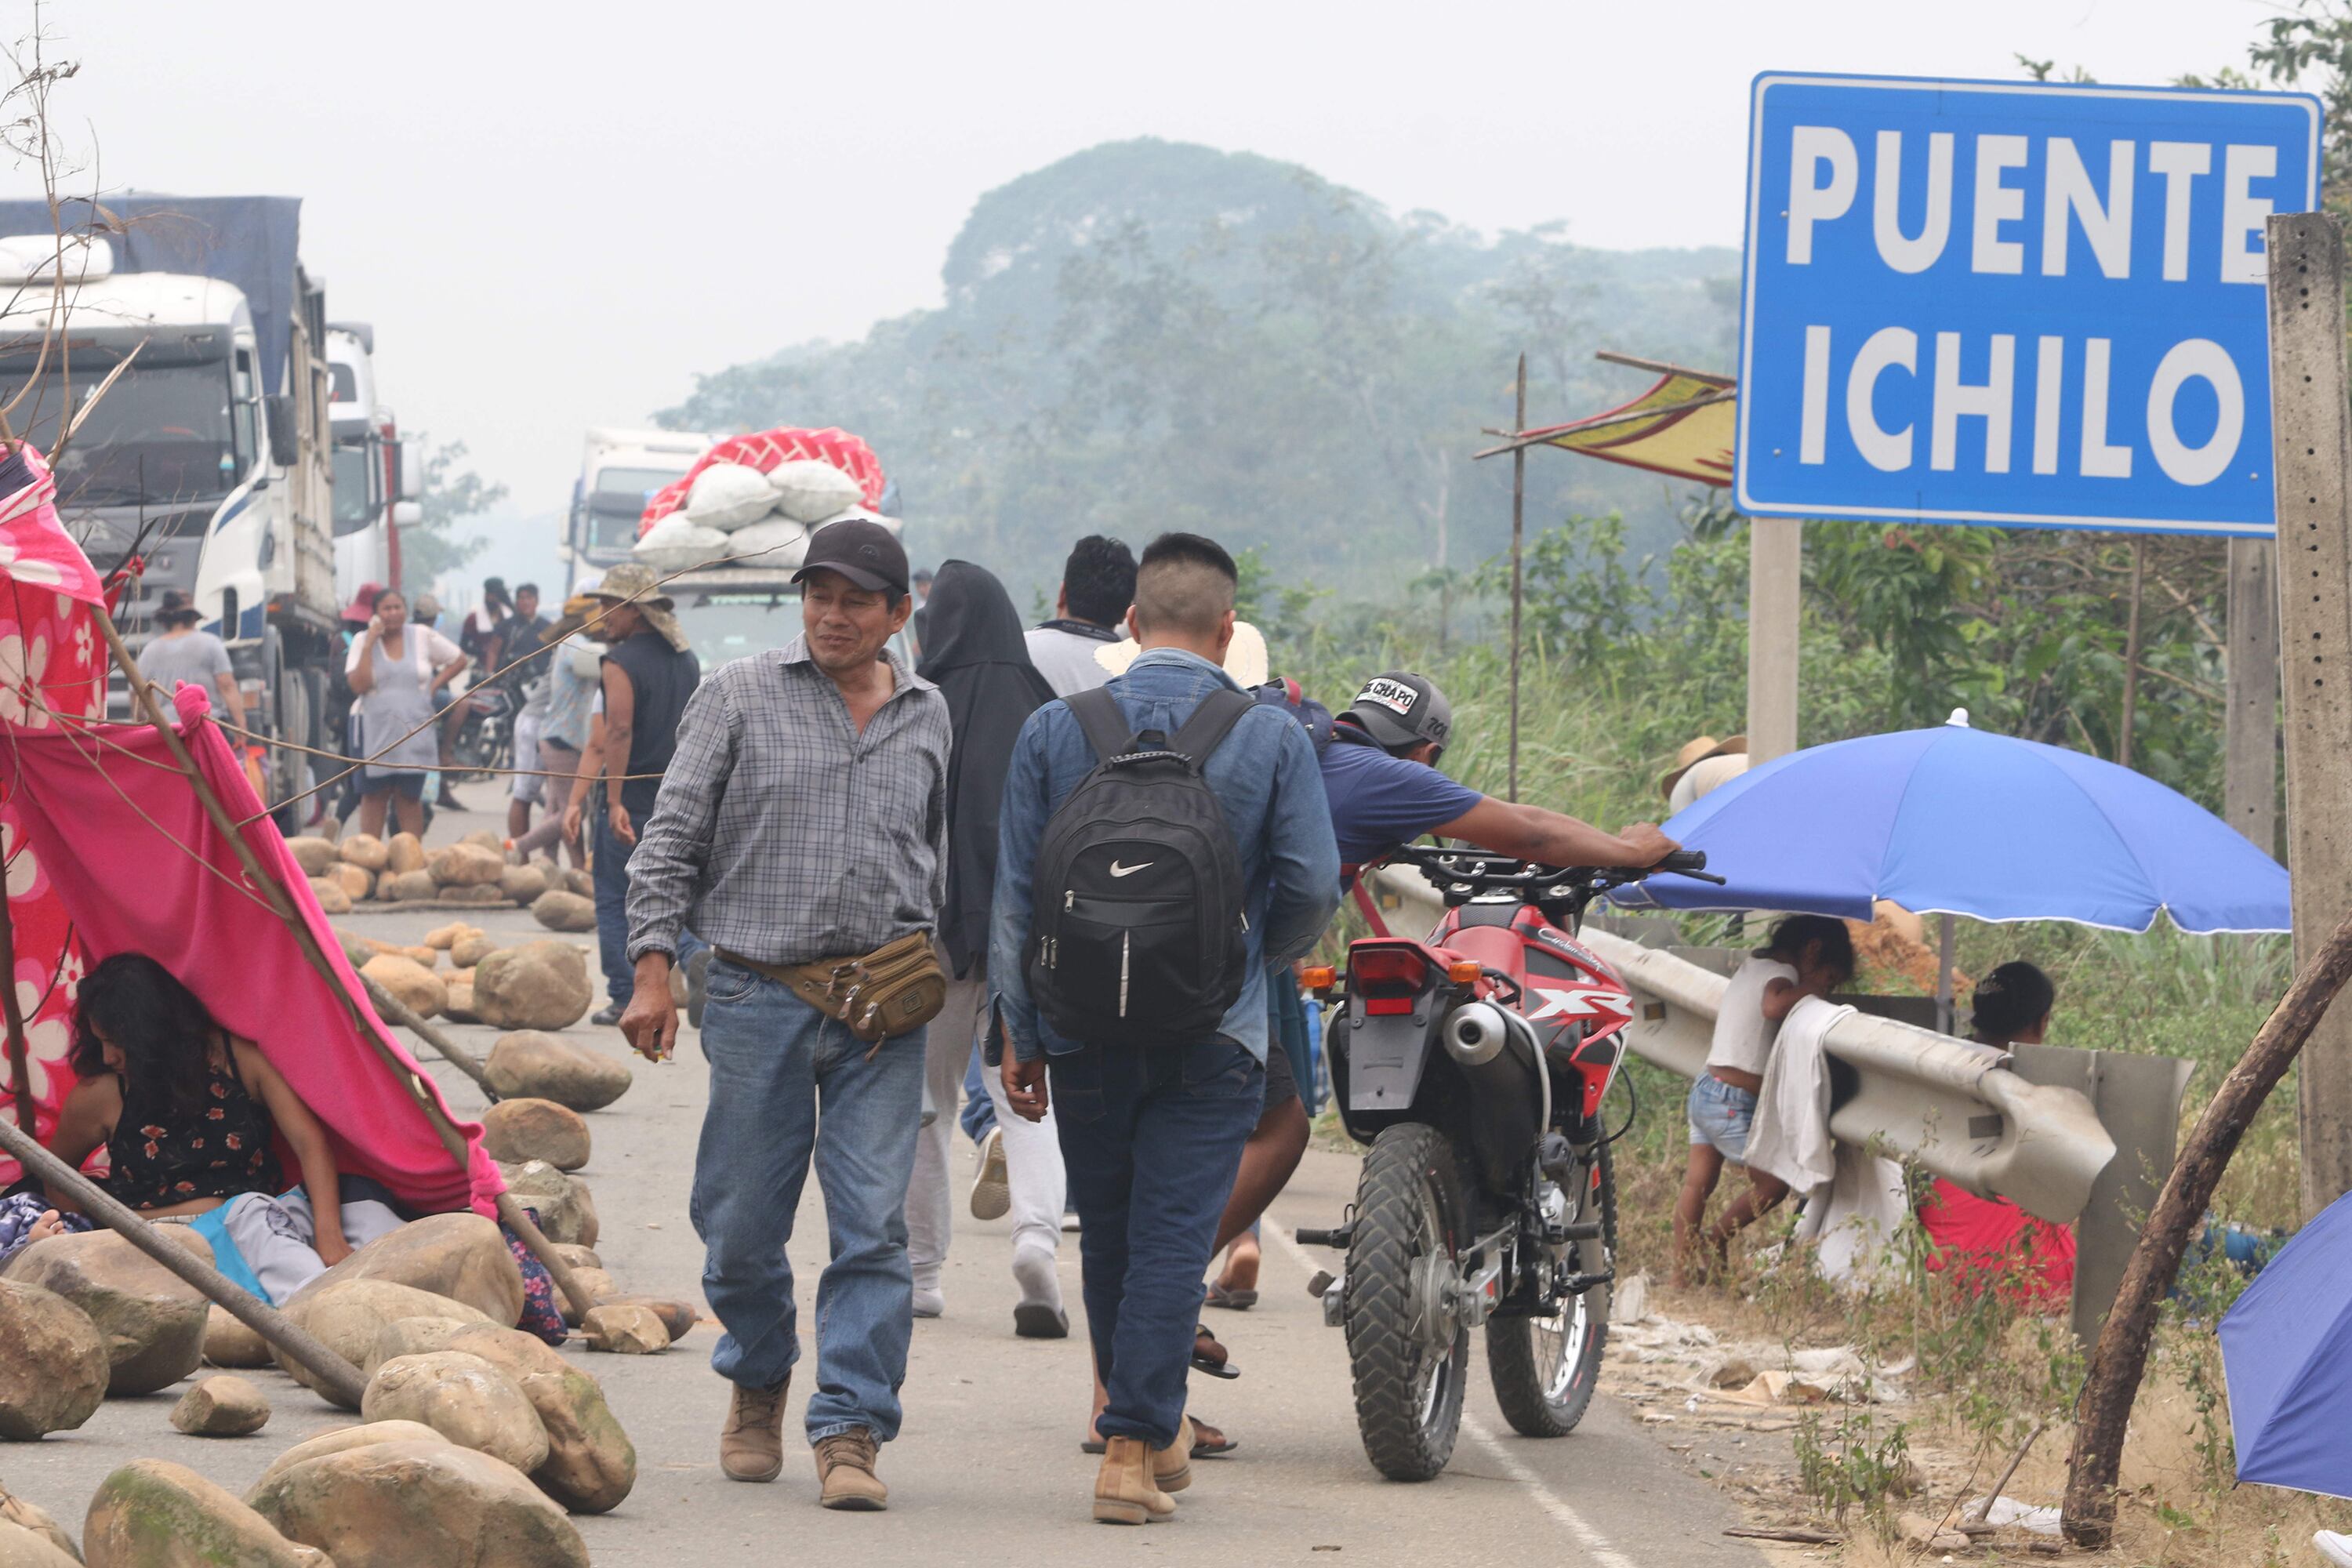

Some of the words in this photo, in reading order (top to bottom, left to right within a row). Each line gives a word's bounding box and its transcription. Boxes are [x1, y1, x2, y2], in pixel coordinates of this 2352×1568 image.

[1785, 125, 2278, 284] PUENTE
[1799, 325, 2245, 486] ICHILO
[1373, 682, 1414, 707] CHAPO
[1526, 988, 1634, 1019] XR
